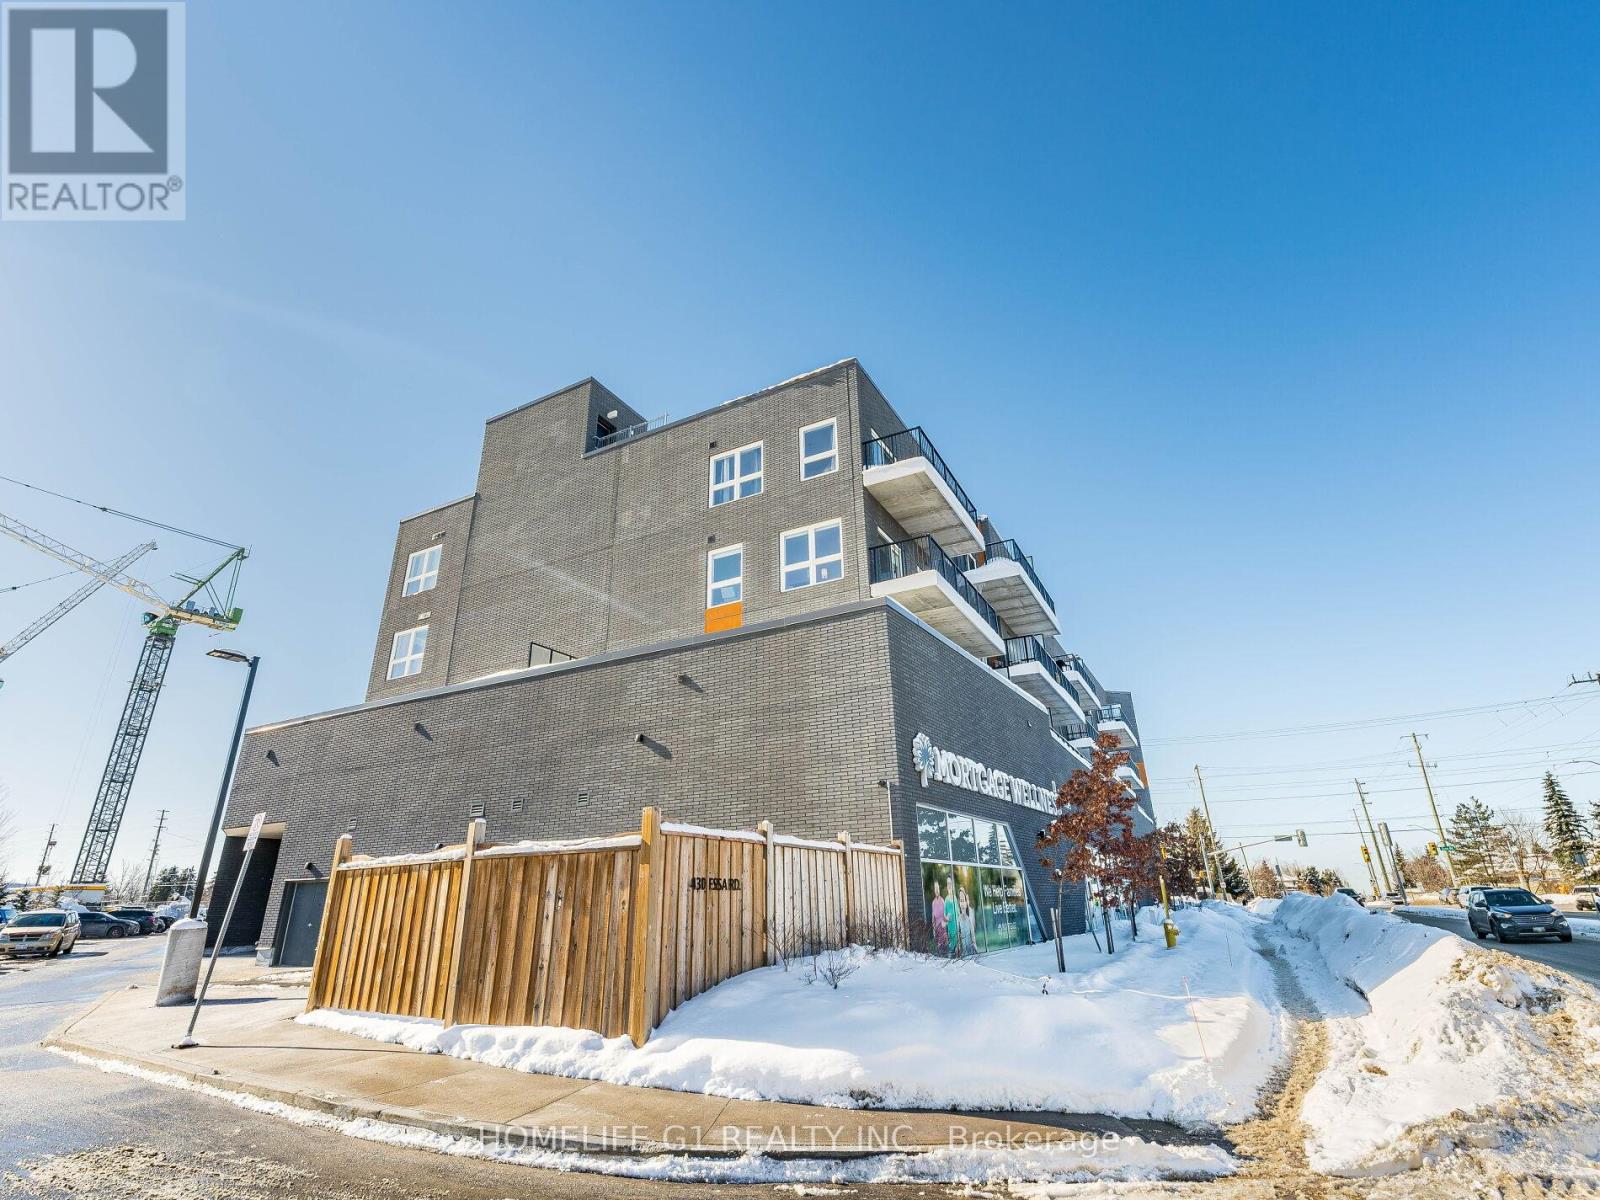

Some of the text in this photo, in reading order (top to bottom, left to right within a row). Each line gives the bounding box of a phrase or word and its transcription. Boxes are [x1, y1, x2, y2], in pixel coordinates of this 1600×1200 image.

[932, 746, 1062, 817] MORTGAGE WELLNES
[690, 877, 706, 890] 430
[708, 878, 727, 890] ESSA
